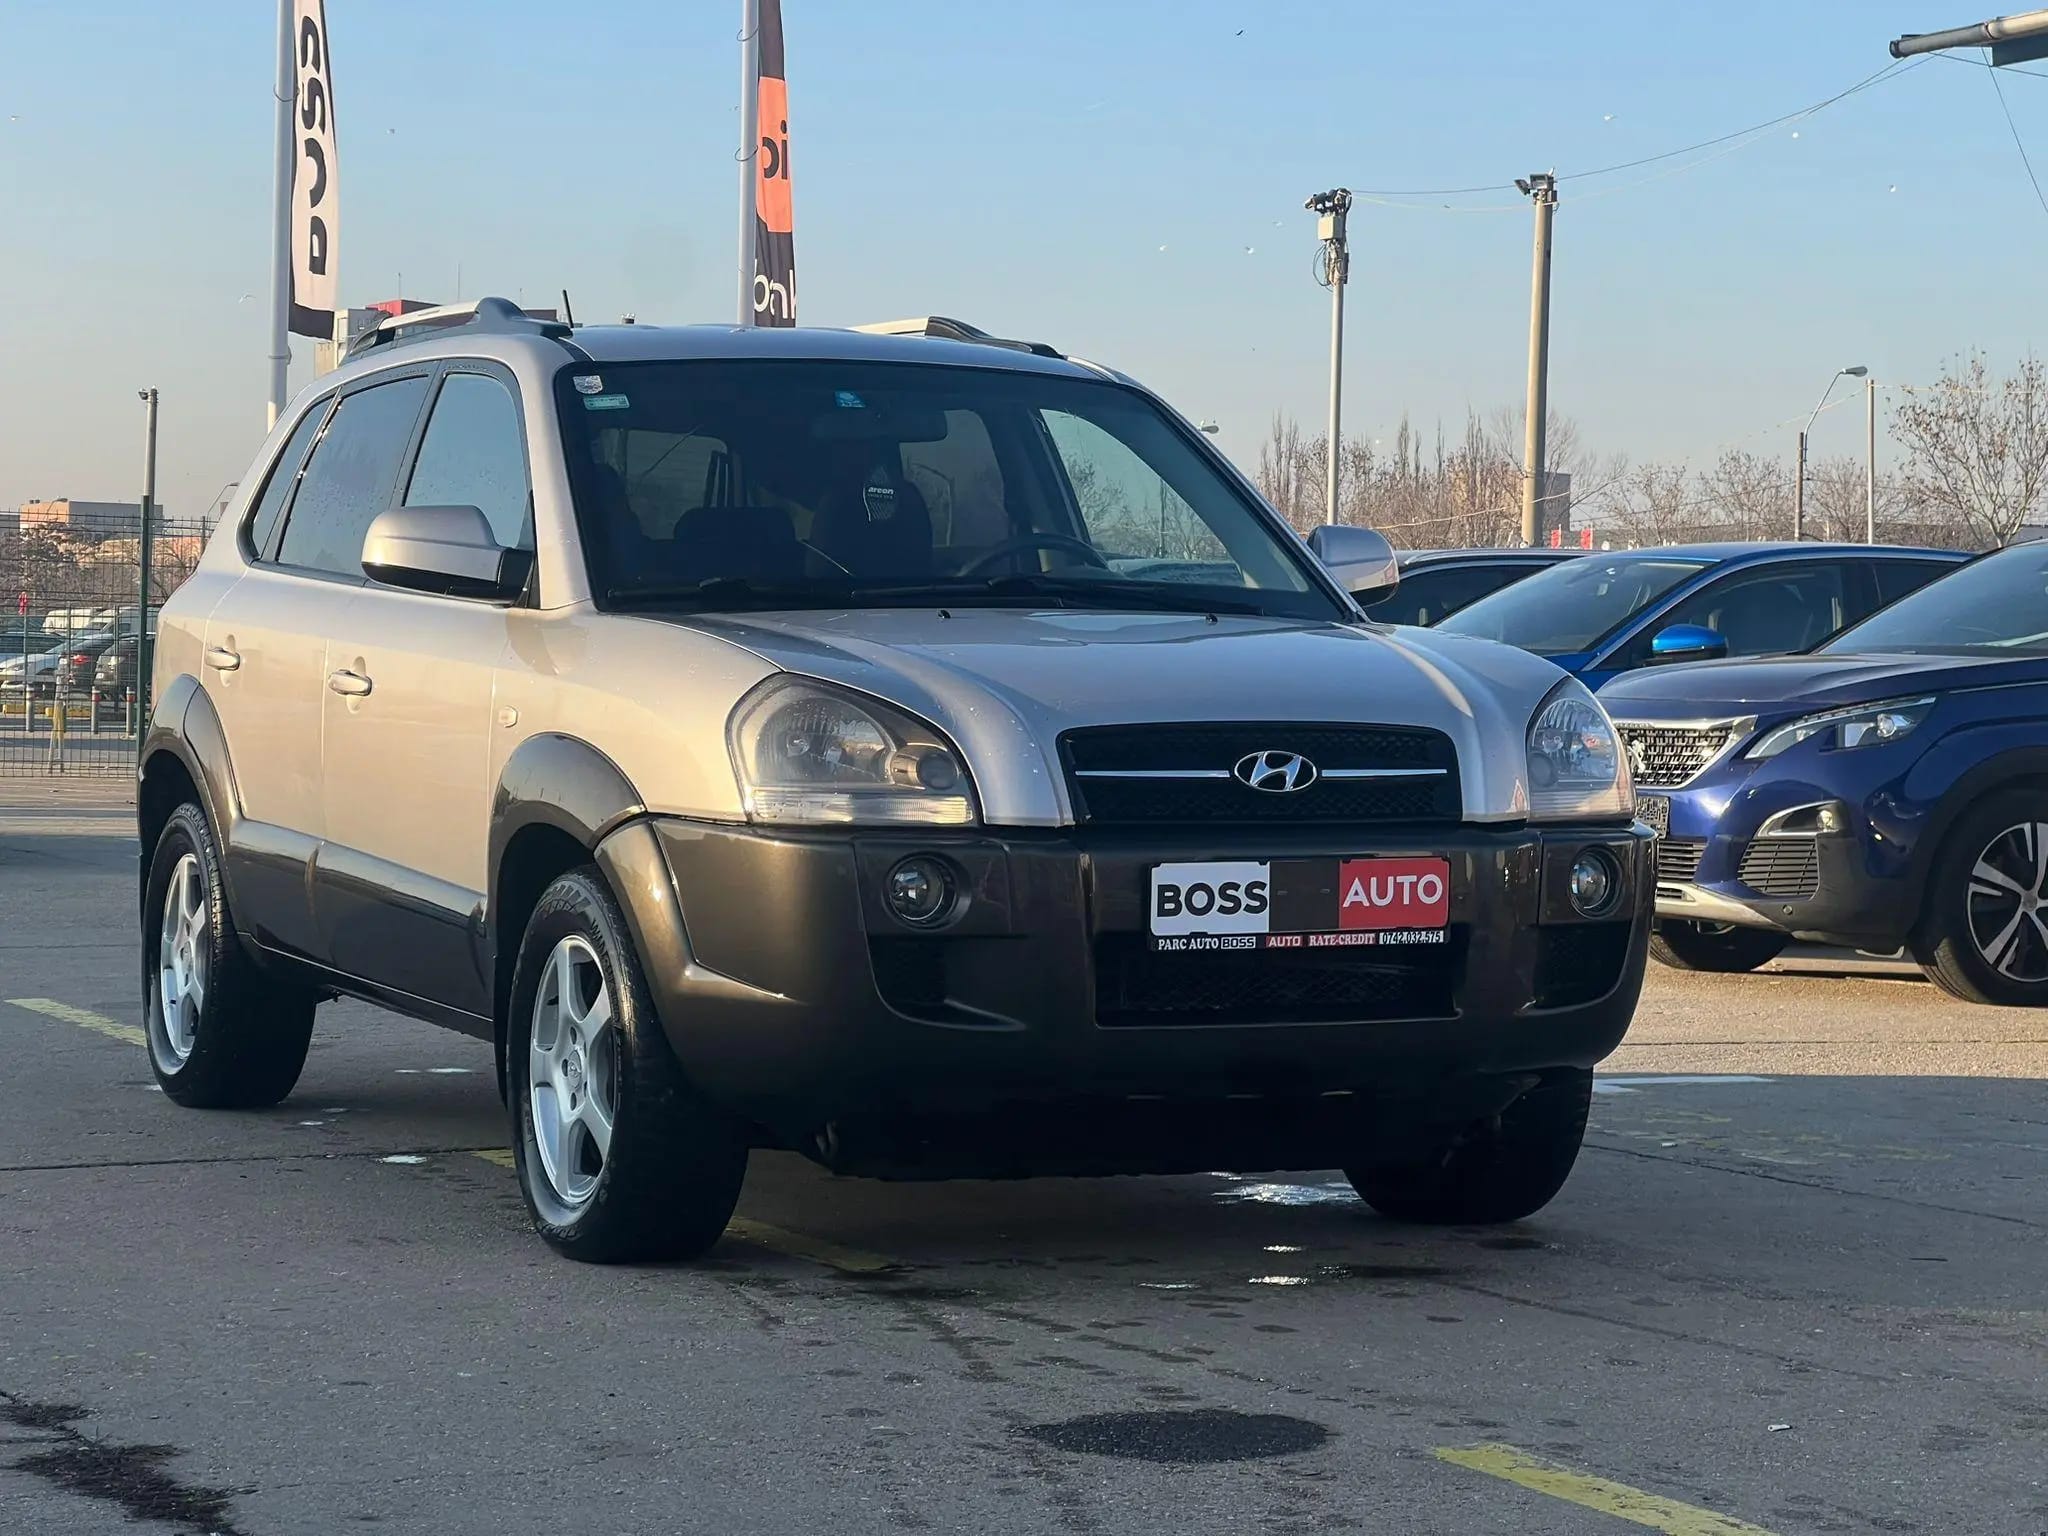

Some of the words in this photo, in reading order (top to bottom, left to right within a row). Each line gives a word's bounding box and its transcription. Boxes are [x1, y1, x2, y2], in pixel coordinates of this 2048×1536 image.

[867, 486, 895, 495] areon
[1156, 880, 1269, 917] BOSS
[1342, 873, 1443, 907] AUTO
[1158, 938, 1187, 950] PARC
[1188, 937, 1219, 949] AUTO
[1222, 937, 1255, 948] BOSS
[1267, 935, 1301, 947] AUTO
